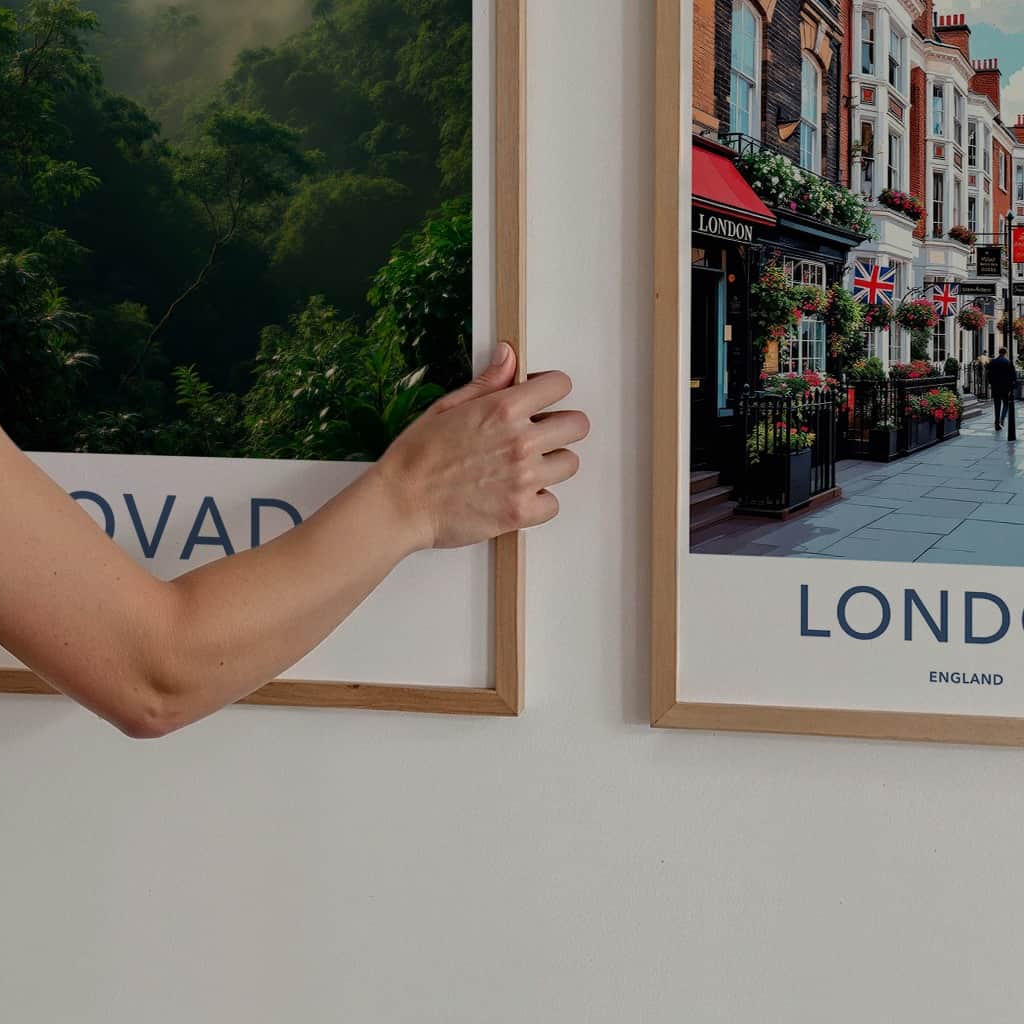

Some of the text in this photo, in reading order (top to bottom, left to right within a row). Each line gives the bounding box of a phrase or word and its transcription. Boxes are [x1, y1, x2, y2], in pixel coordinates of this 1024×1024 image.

[699, 213, 753, 242] LONDON
[800, 584, 1024, 645] LOND
[929, 671, 1004, 687] ENGLAND
